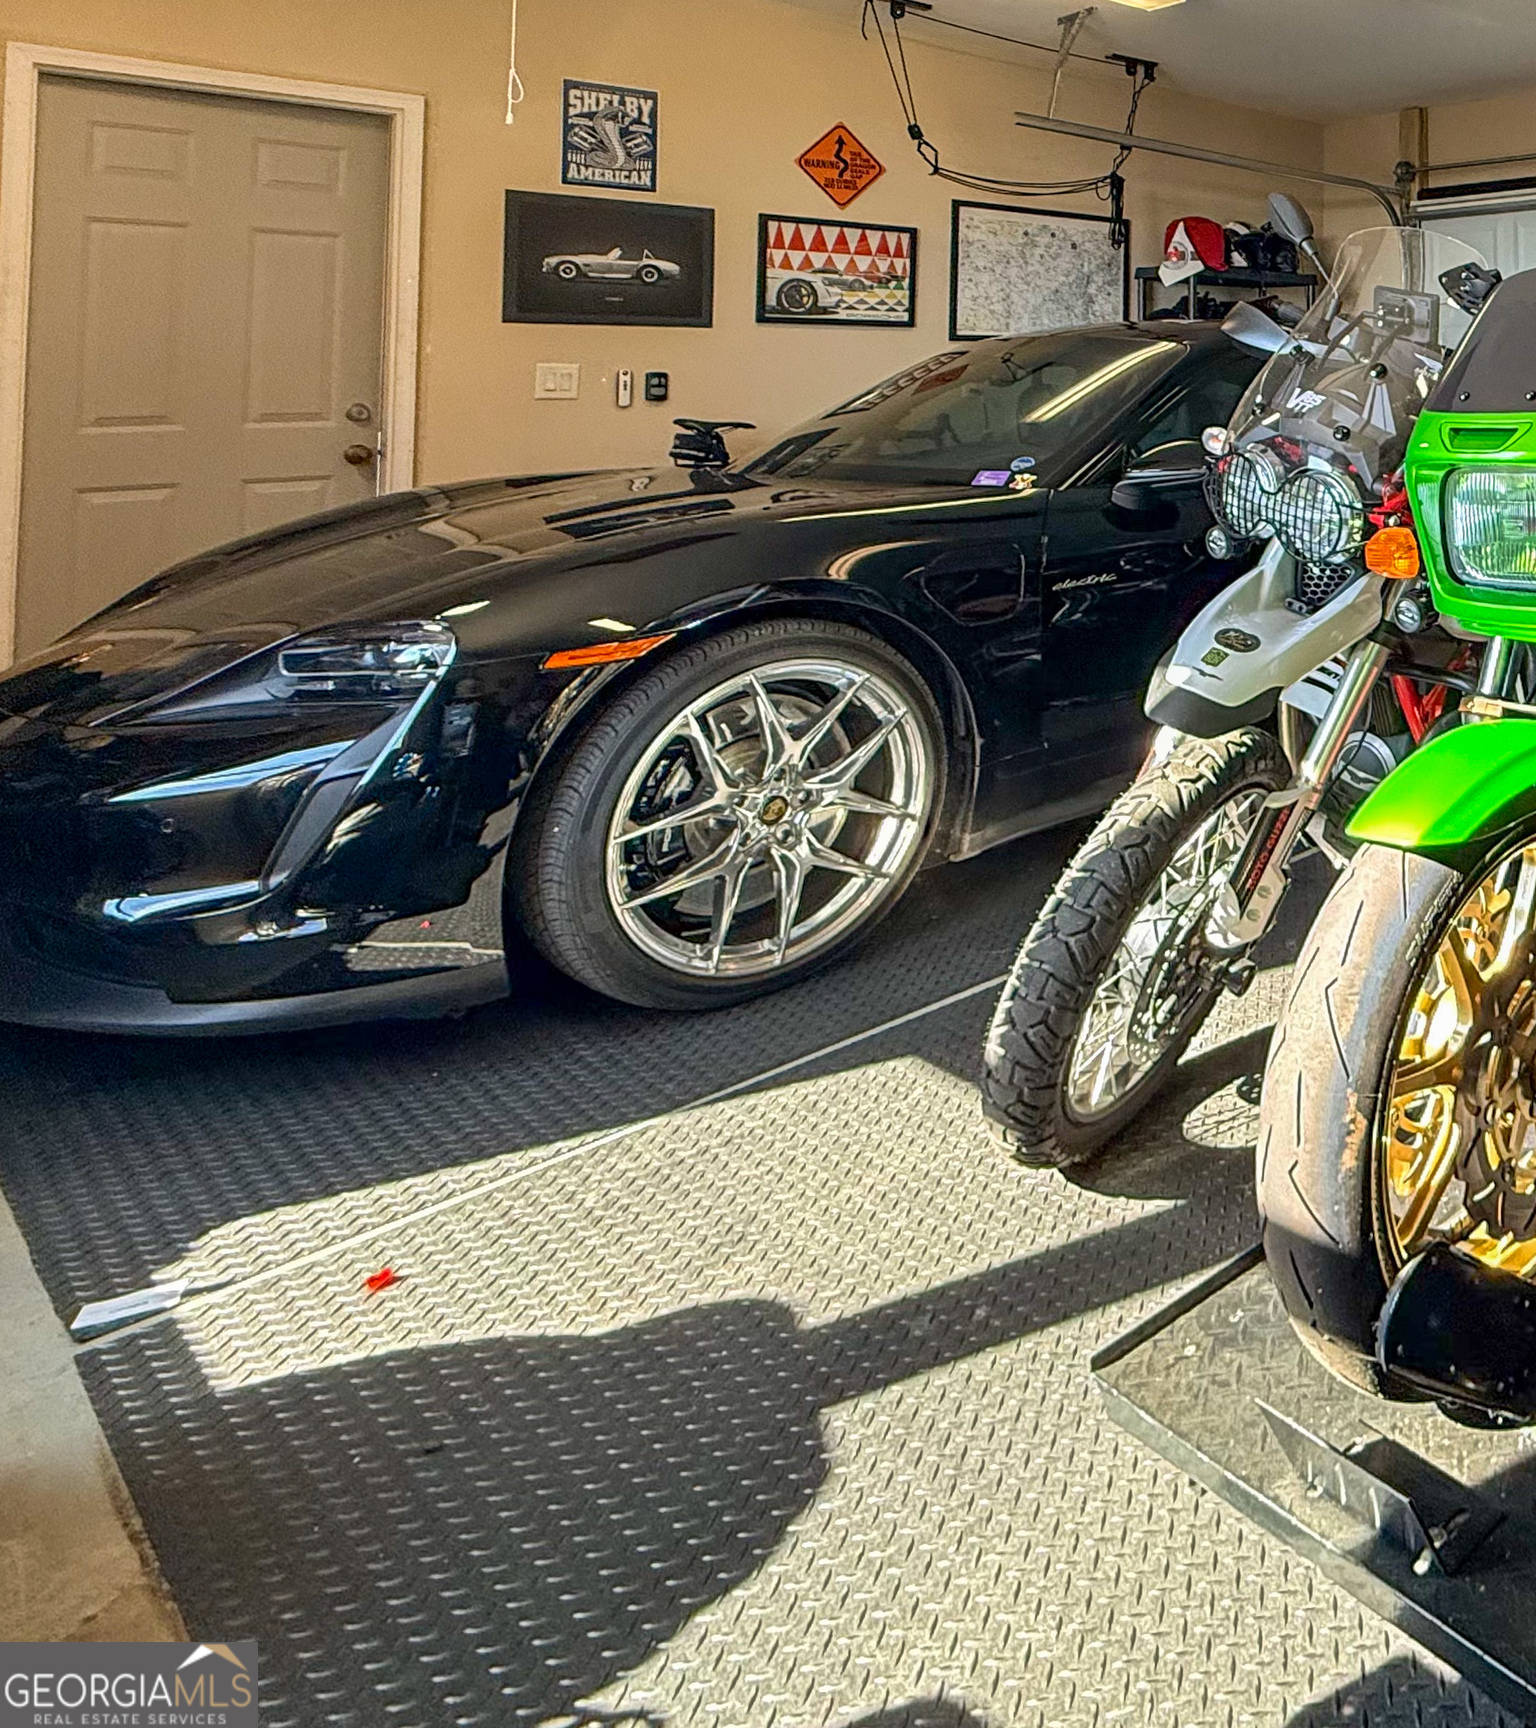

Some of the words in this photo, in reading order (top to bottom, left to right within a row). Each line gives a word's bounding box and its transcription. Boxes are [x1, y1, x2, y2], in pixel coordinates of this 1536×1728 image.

[568, 88, 653, 125] SHELBY
[567, 162, 652, 188] AMERICAN
[803, 158, 840, 170] WARNING
[1052, 573, 1118, 591] electric
[1246, 851, 1269, 890] MOTO
